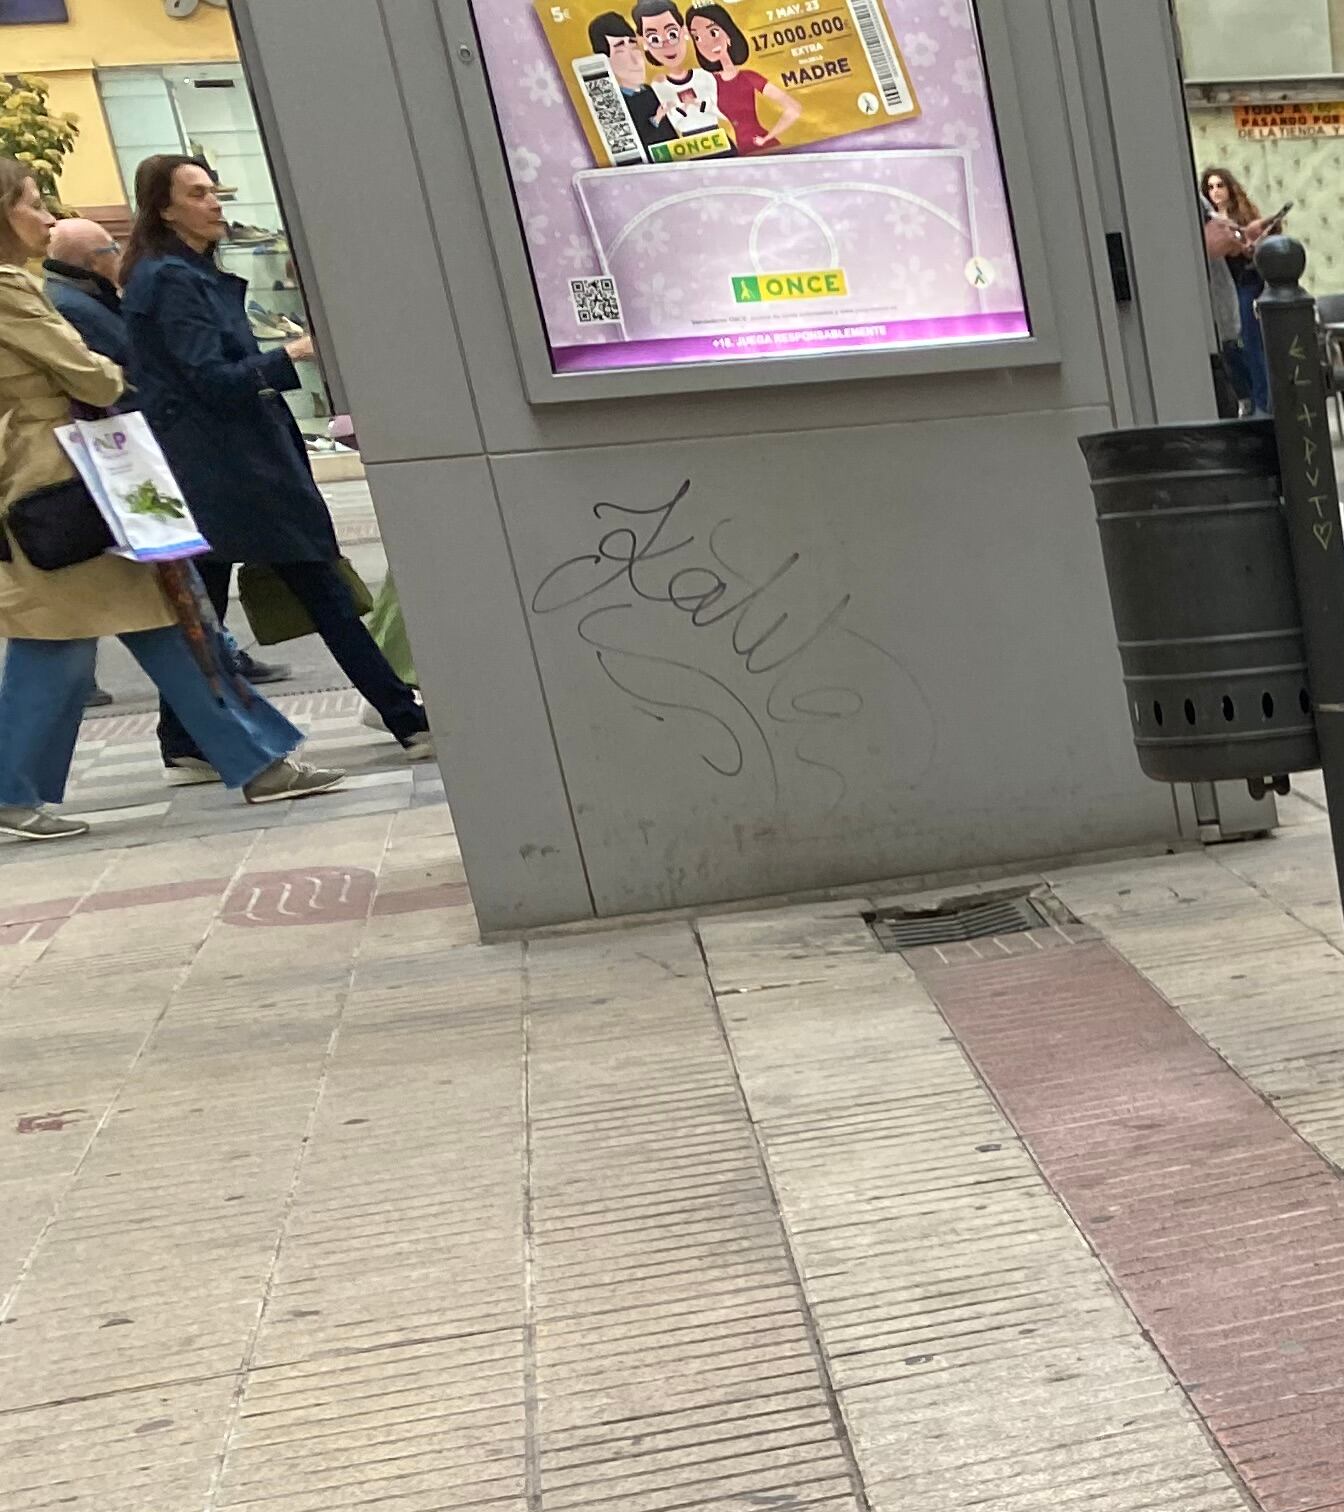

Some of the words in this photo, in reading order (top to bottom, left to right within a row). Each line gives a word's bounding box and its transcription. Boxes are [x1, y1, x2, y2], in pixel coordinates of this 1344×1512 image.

[790, 42, 824, 57] EXTRA
[781, 57, 851, 88] MADRE
[1241, 115, 1307, 127] PASANDO
[1313, 113, 1340, 125] POR
[1280, 125, 1326, 137] TIENDA
[674, 134, 723, 156] ONCE
[766, 274, 840, 296] ONCE
[736, 333, 773, 347] JUEGA
